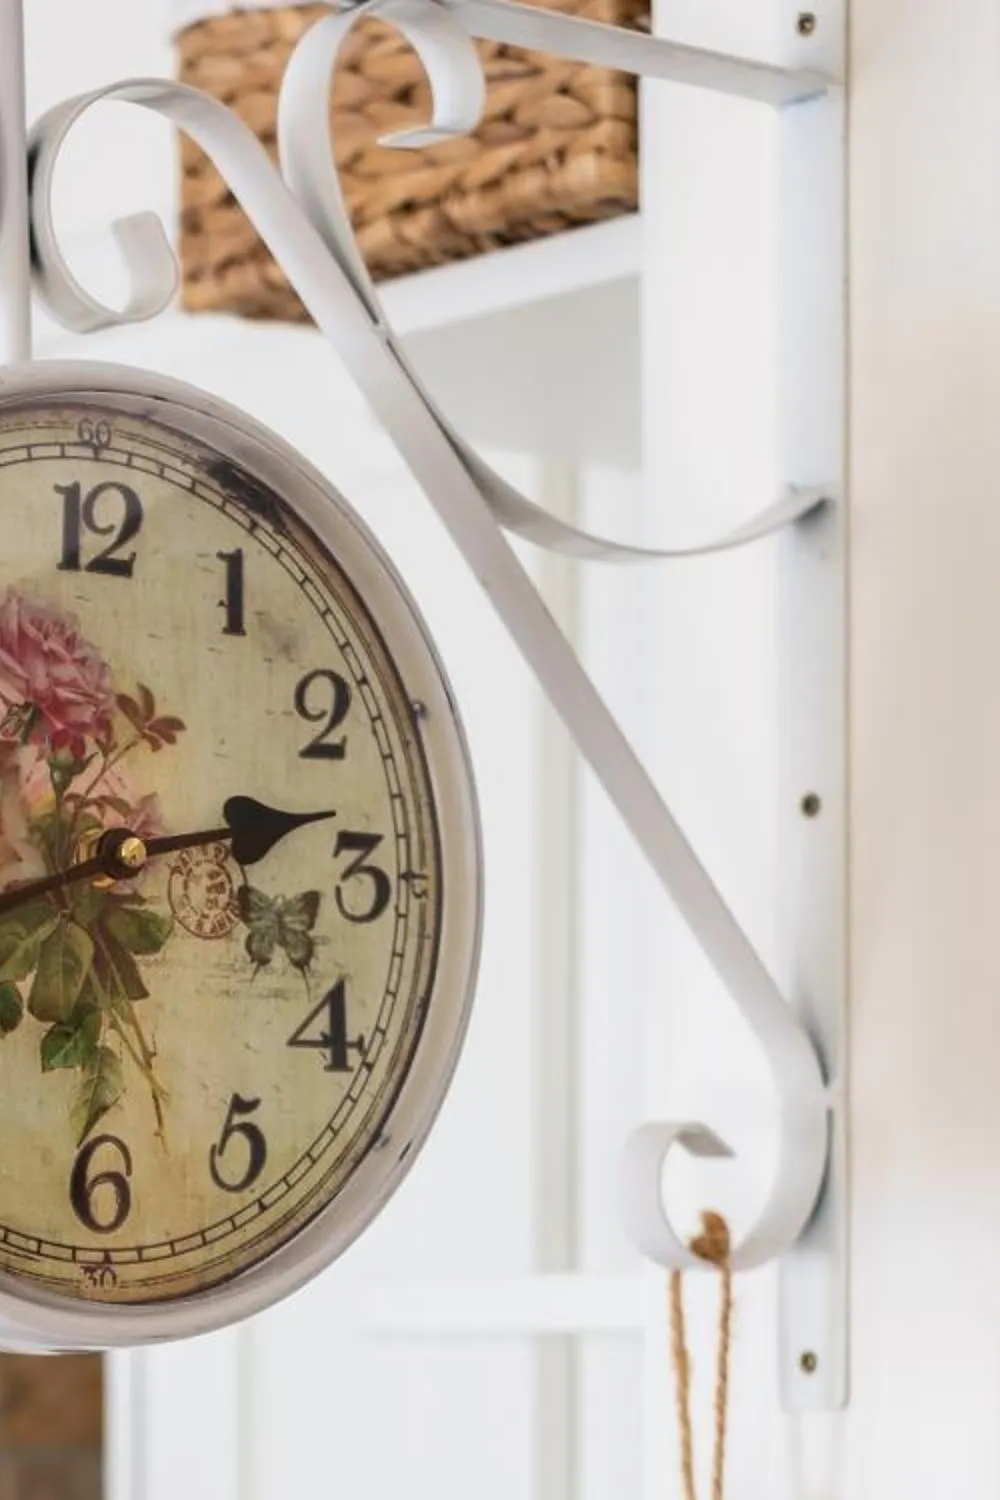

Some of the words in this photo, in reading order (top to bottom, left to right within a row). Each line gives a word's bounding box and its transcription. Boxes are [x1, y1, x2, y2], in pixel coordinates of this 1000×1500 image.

[54, 482, 142, 578] 12
[216, 548, 246, 636] 1
[294, 669, 350, 759] 2
[332, 832, 391, 923] 3
[286, 978, 364, 1072] 4
[70, 1134, 133, 1234] 6
[210, 1094, 268, 1193] 5
